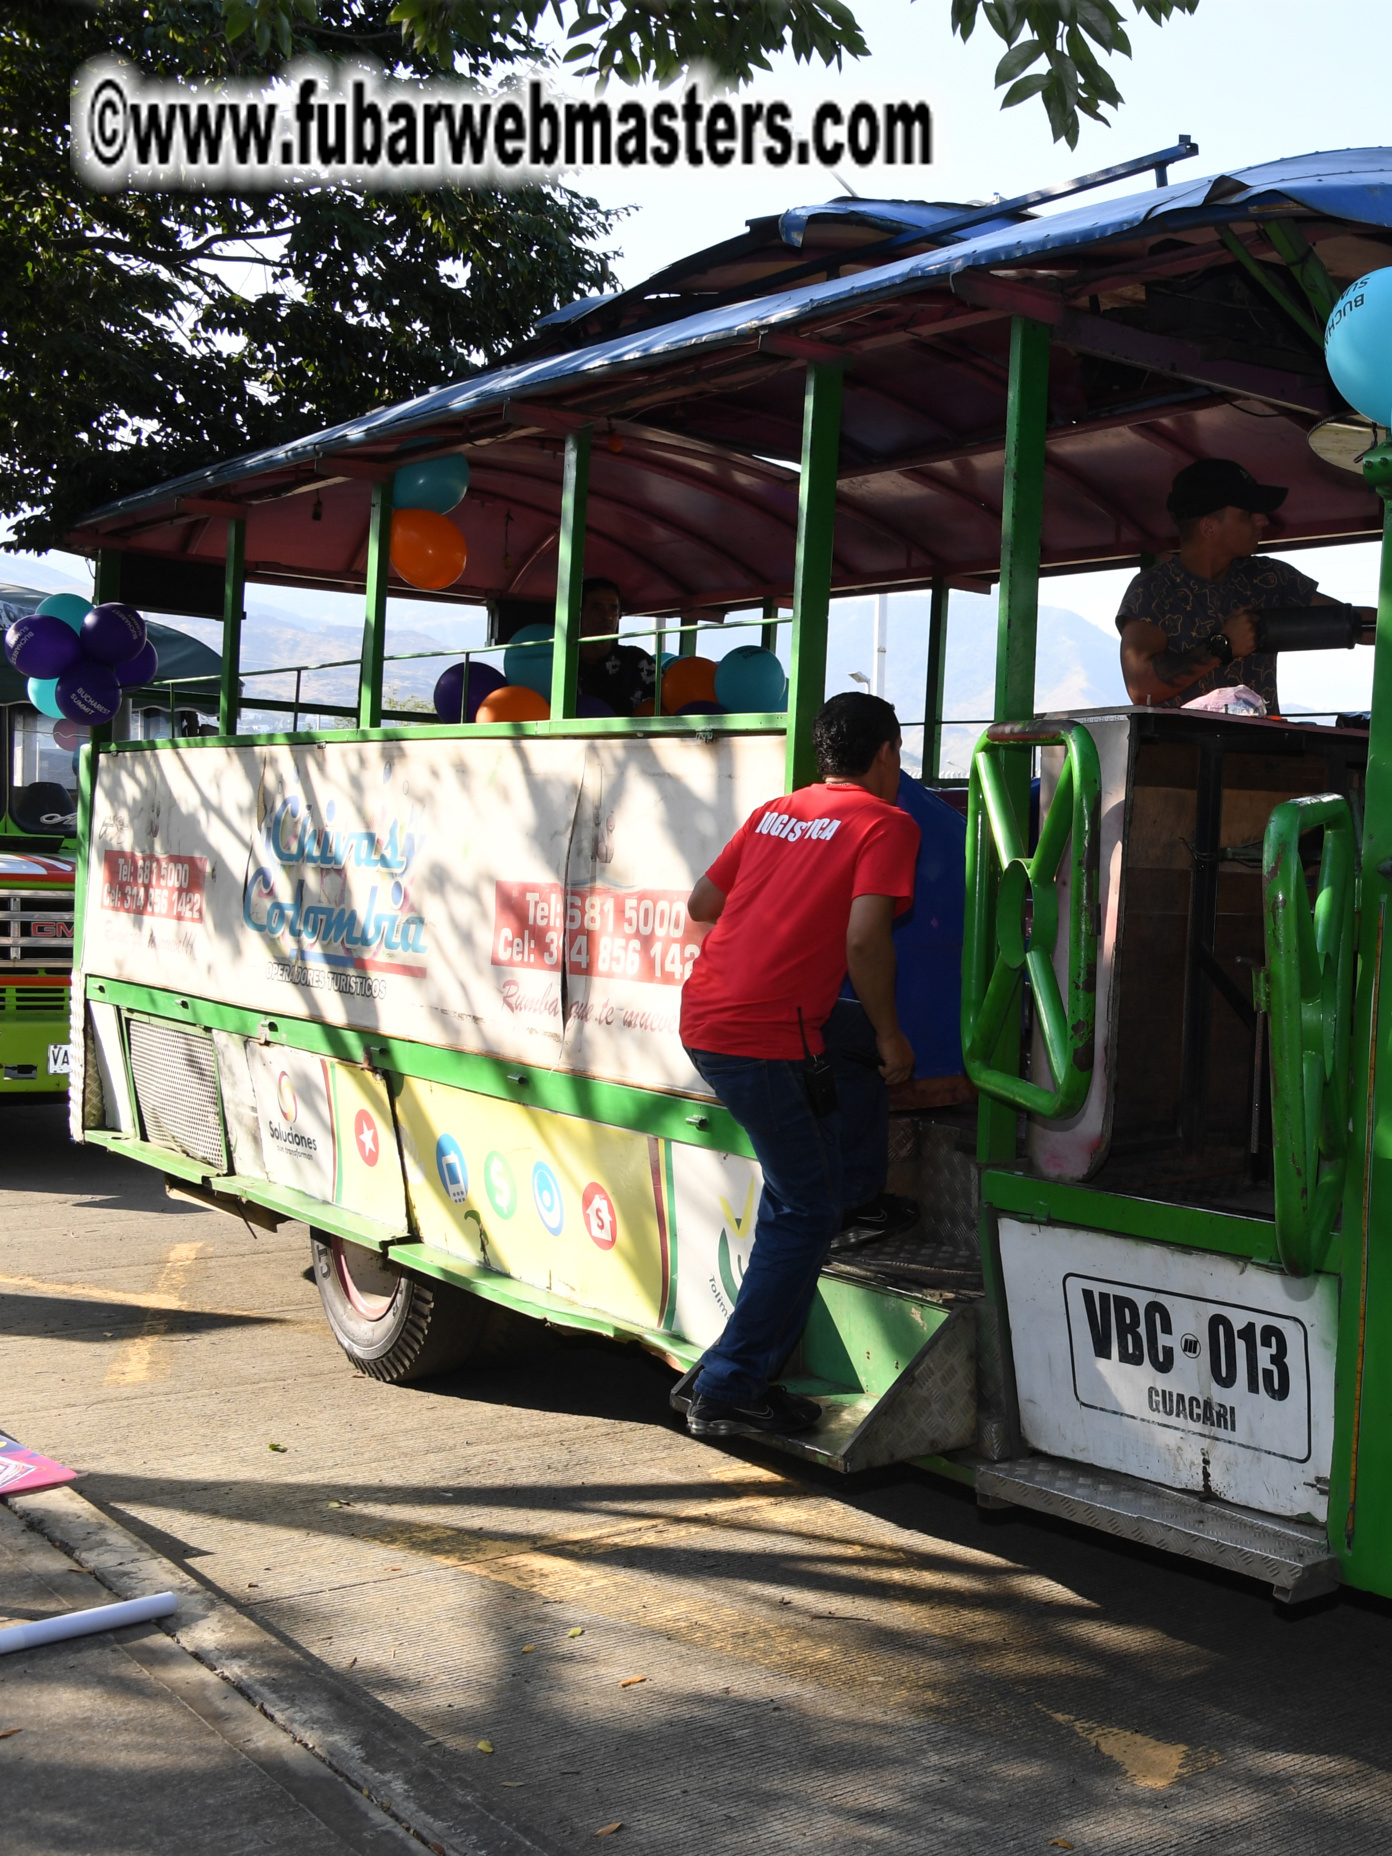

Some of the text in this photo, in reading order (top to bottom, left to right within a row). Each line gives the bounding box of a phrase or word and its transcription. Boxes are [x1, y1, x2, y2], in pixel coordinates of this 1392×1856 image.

[70, 693, 96, 716] SUMMIT
[77, 687, 111, 716] BUCHAREST
[271, 795, 407, 870] Chivas
[118, 858, 190, 888] Tel: 681 5000
[103, 882, 201, 919] Cel: 314 856 1422
[243, 866, 428, 954] Colombia
[526, 892, 687, 938] Tel: 681 5000
[499, 927, 535, 963] Cel:
[598, 936, 642, 975] 856
[265, 961, 387, 1000] OPERADORES TURISTICOS
[501, 979, 560, 1016] Rumba
[269, 1120, 318, 1151] Soluciones
[1081, 1287, 1291, 1402] VBC 013
[1147, 1385, 1237, 1433] GUACARI
